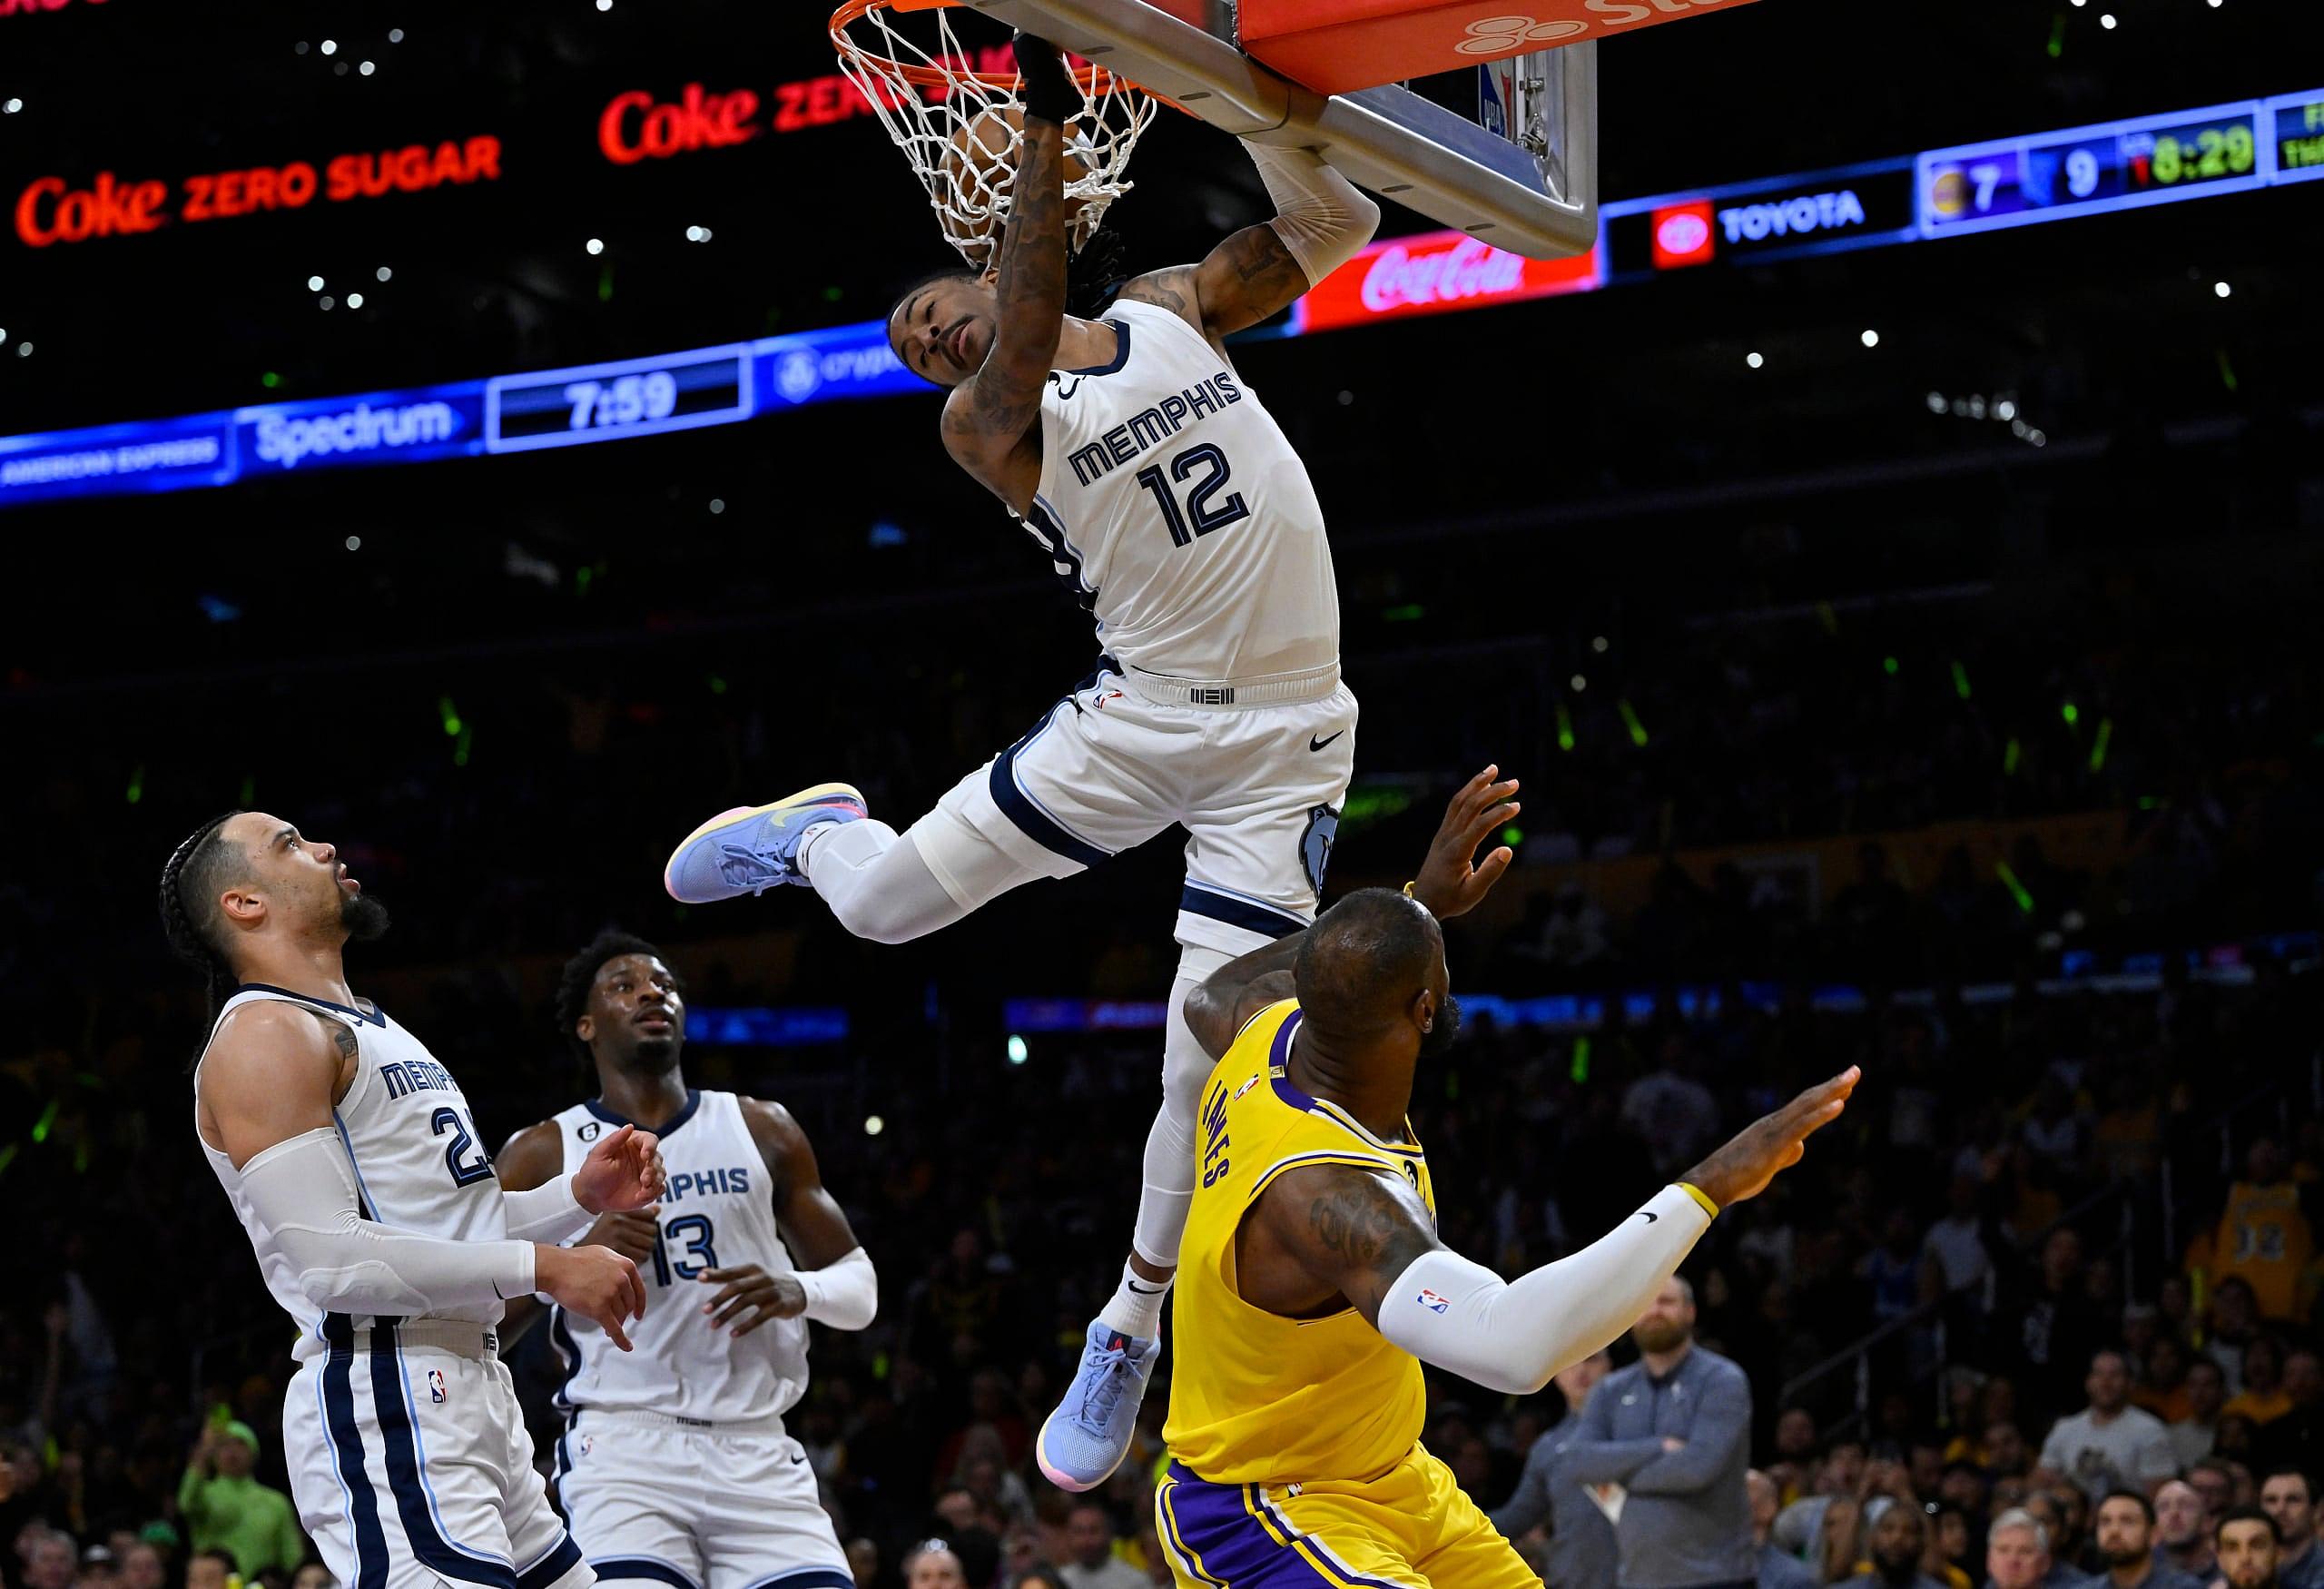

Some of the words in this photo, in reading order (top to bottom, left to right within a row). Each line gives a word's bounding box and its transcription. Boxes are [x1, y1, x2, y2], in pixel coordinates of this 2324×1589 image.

[598, 84, 759, 163] Coke
[1484, 99, 1502, 129] NBA
[15, 172, 167, 246] Coke
[182, 162, 316, 222] ZERO
[327, 135, 501, 201] SUGAR
[1968, 163, 2002, 212] 7
[2065, 148, 2100, 198] 9
[1718, 190, 1866, 244] TOYOTA
[255, 401, 453, 469] Spectrum
[564, 370, 677, 429] 7:59
[1067, 371, 1243, 488] MEMPHIS
[1136, 441, 1251, 549] 12
[431, 1106, 496, 1189] 2
[1202, 1079, 1230, 1189] JAMES
[651, 1213, 720, 1288] 13
